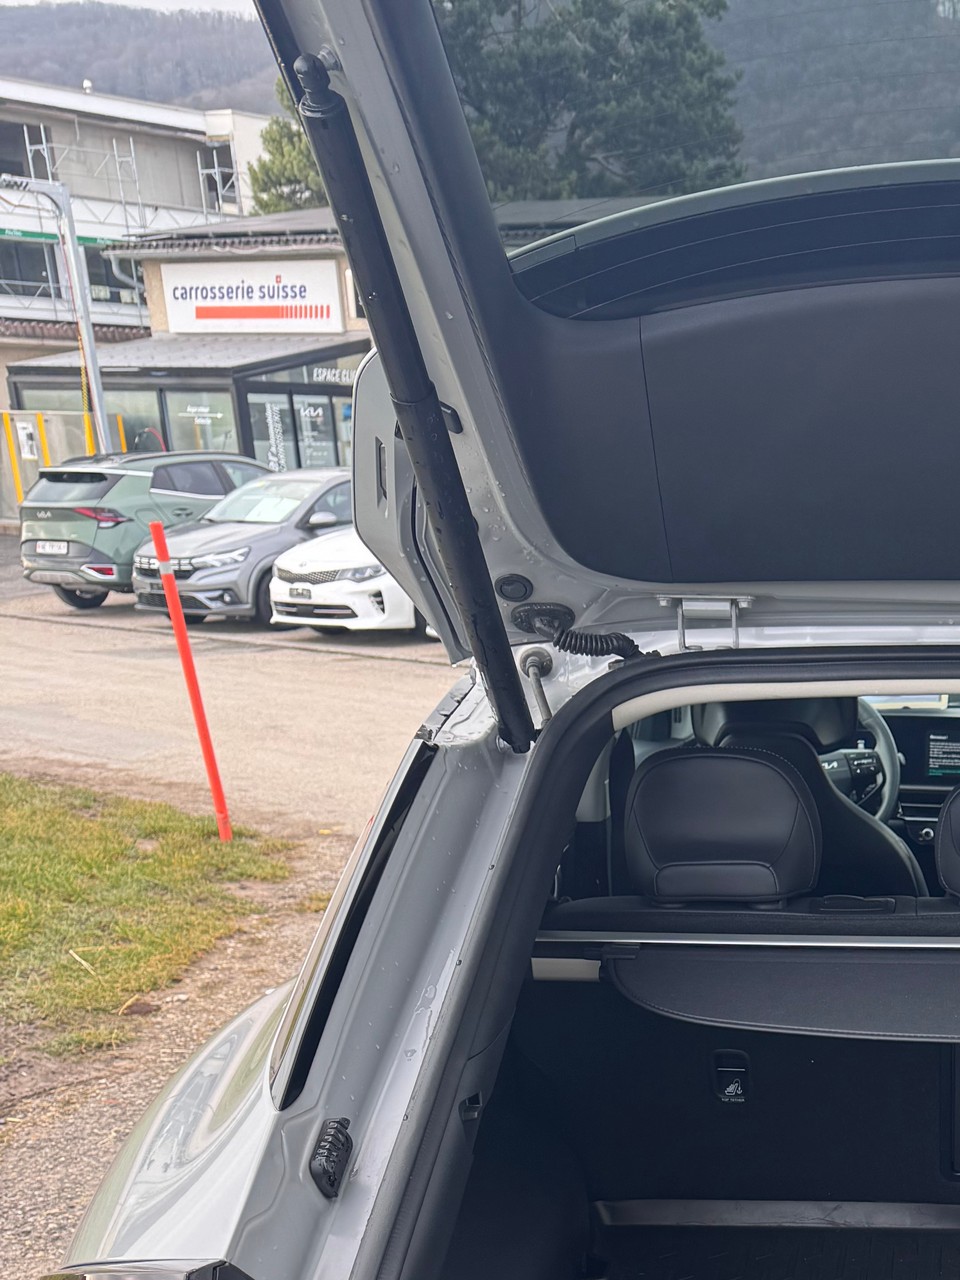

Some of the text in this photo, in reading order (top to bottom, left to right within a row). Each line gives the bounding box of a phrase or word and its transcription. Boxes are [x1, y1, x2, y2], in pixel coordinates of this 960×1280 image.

[172, 275, 307, 300] carrosserie suisse
[313, 367, 340, 382] ESPACE
